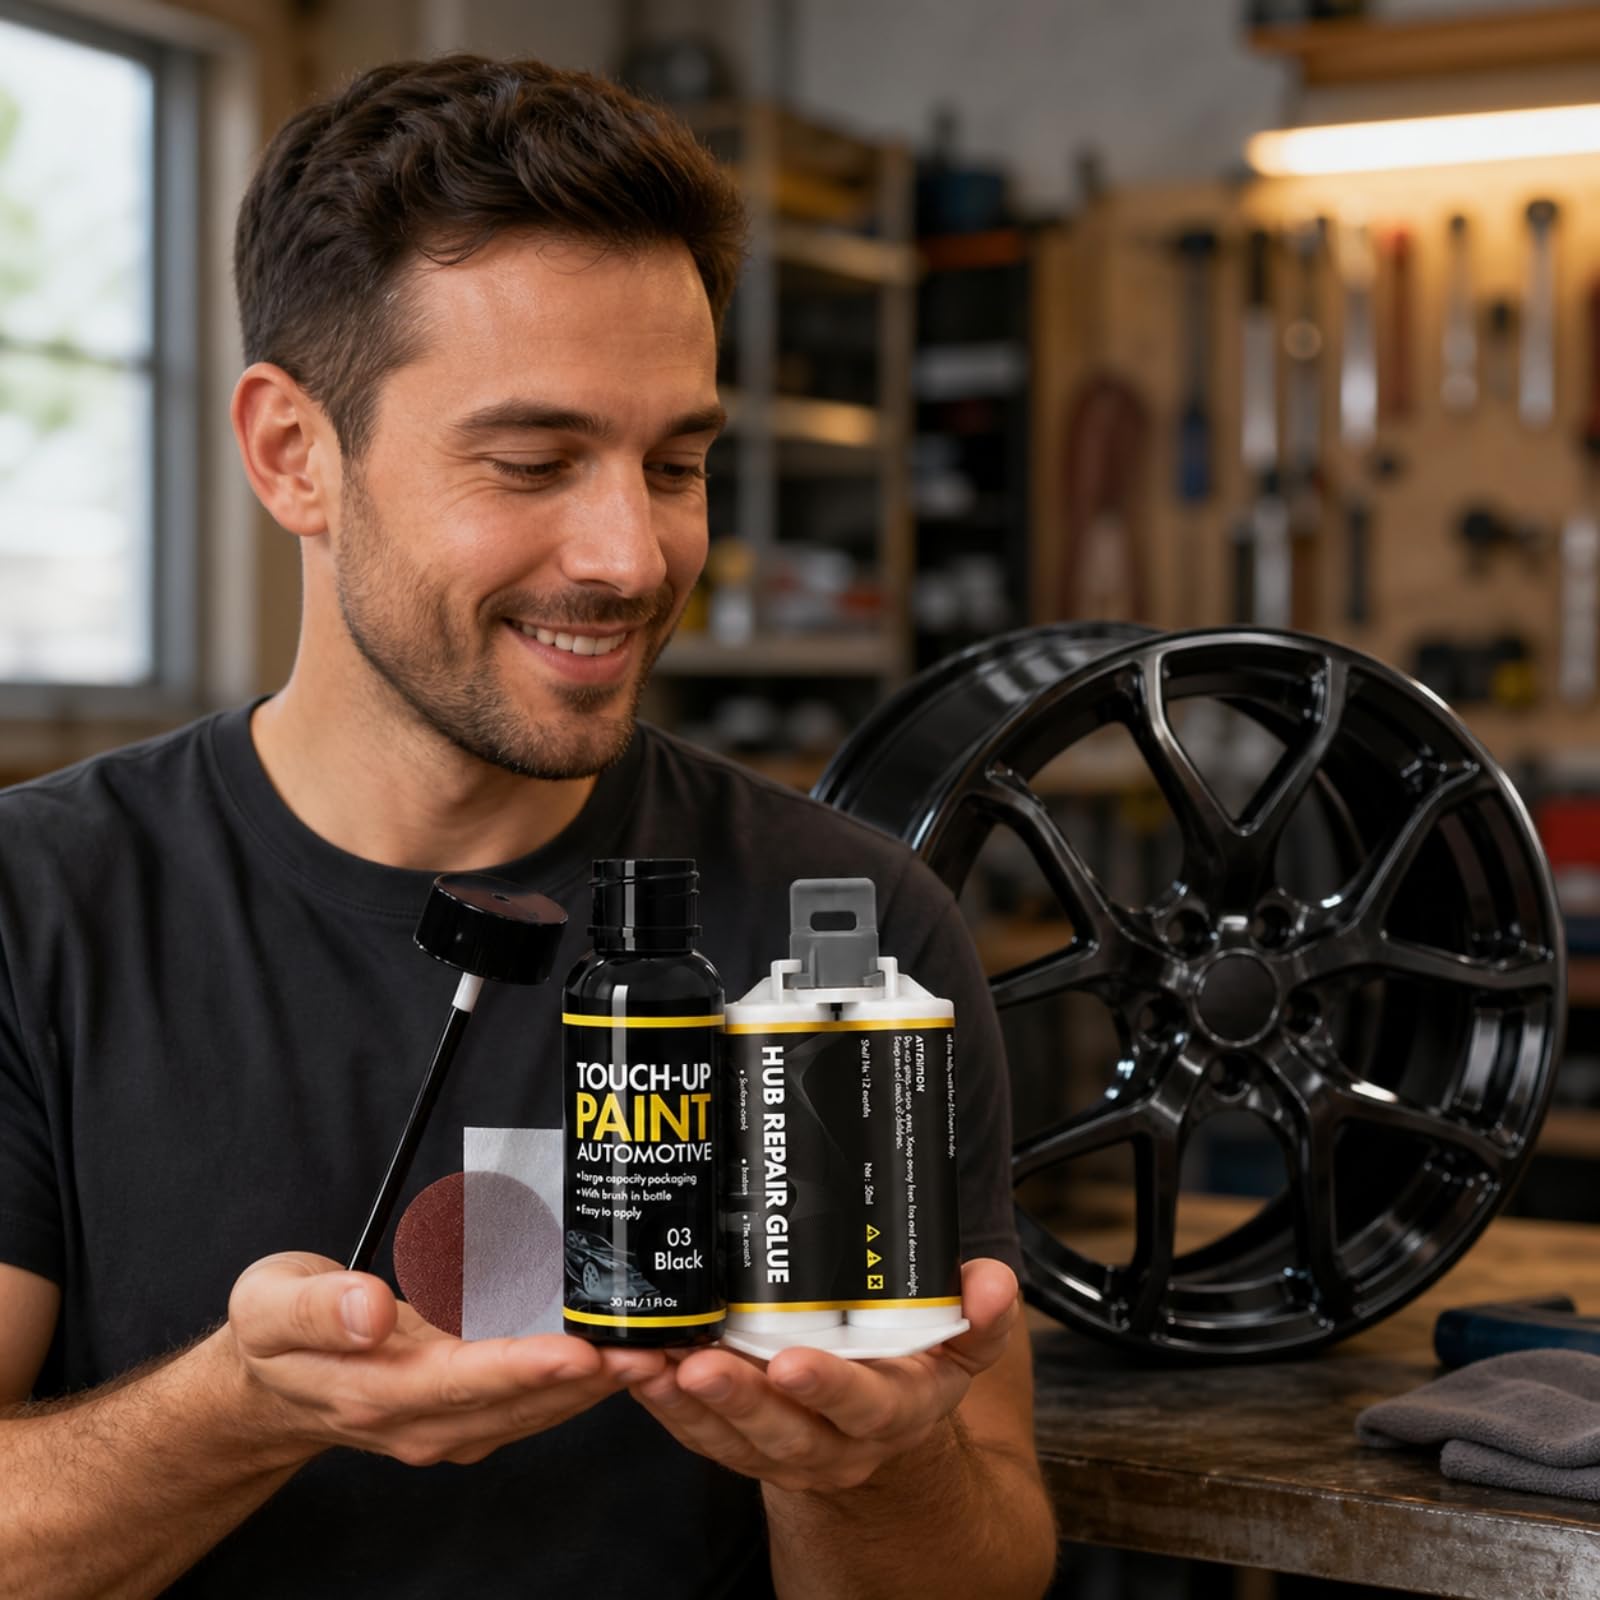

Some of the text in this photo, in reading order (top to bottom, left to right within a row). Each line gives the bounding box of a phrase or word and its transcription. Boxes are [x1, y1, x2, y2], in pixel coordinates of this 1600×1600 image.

[576, 1062, 711, 1091] TOUCH-UP
[576, 1092, 711, 1142] PAINT
[577, 1142, 712, 1164] AUTOMOTIVE
[761, 1046, 789, 1284] HUB REPAIR GLUE
[648, 1172, 697, 1187] packaging
[631, 1190, 640, 1200] in
[613, 1206, 642, 1220] apply
[667, 1227, 691, 1247] 03
[654, 1249, 703, 1270] Black
